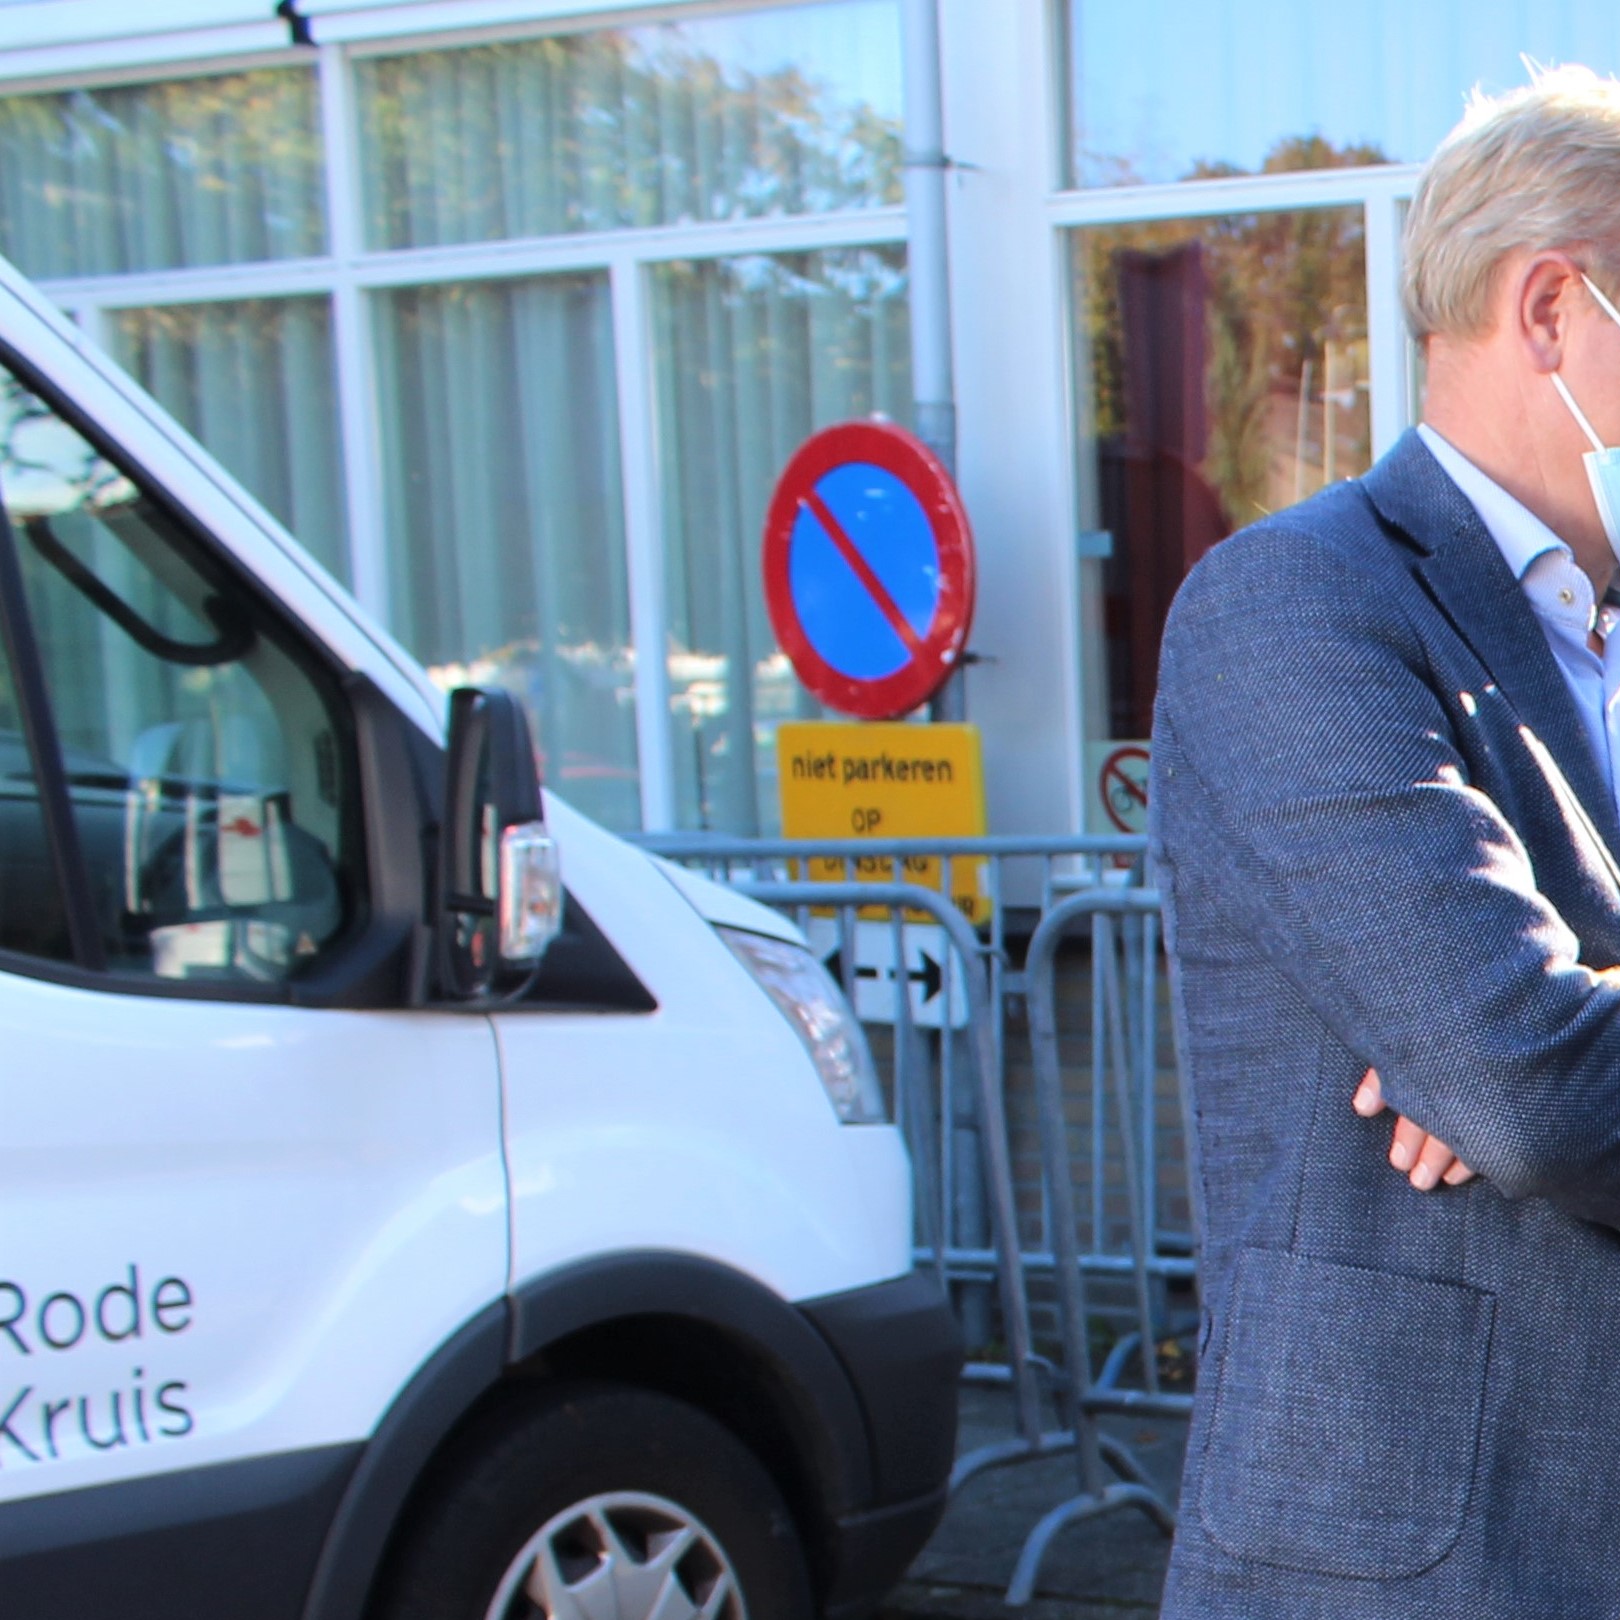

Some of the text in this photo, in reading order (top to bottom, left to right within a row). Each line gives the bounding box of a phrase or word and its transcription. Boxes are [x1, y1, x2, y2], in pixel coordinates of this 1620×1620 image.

[792, 751, 953, 785] niet parkeren
[852, 809, 881, 833] OP
[0, 1262, 193, 1355] Rode
